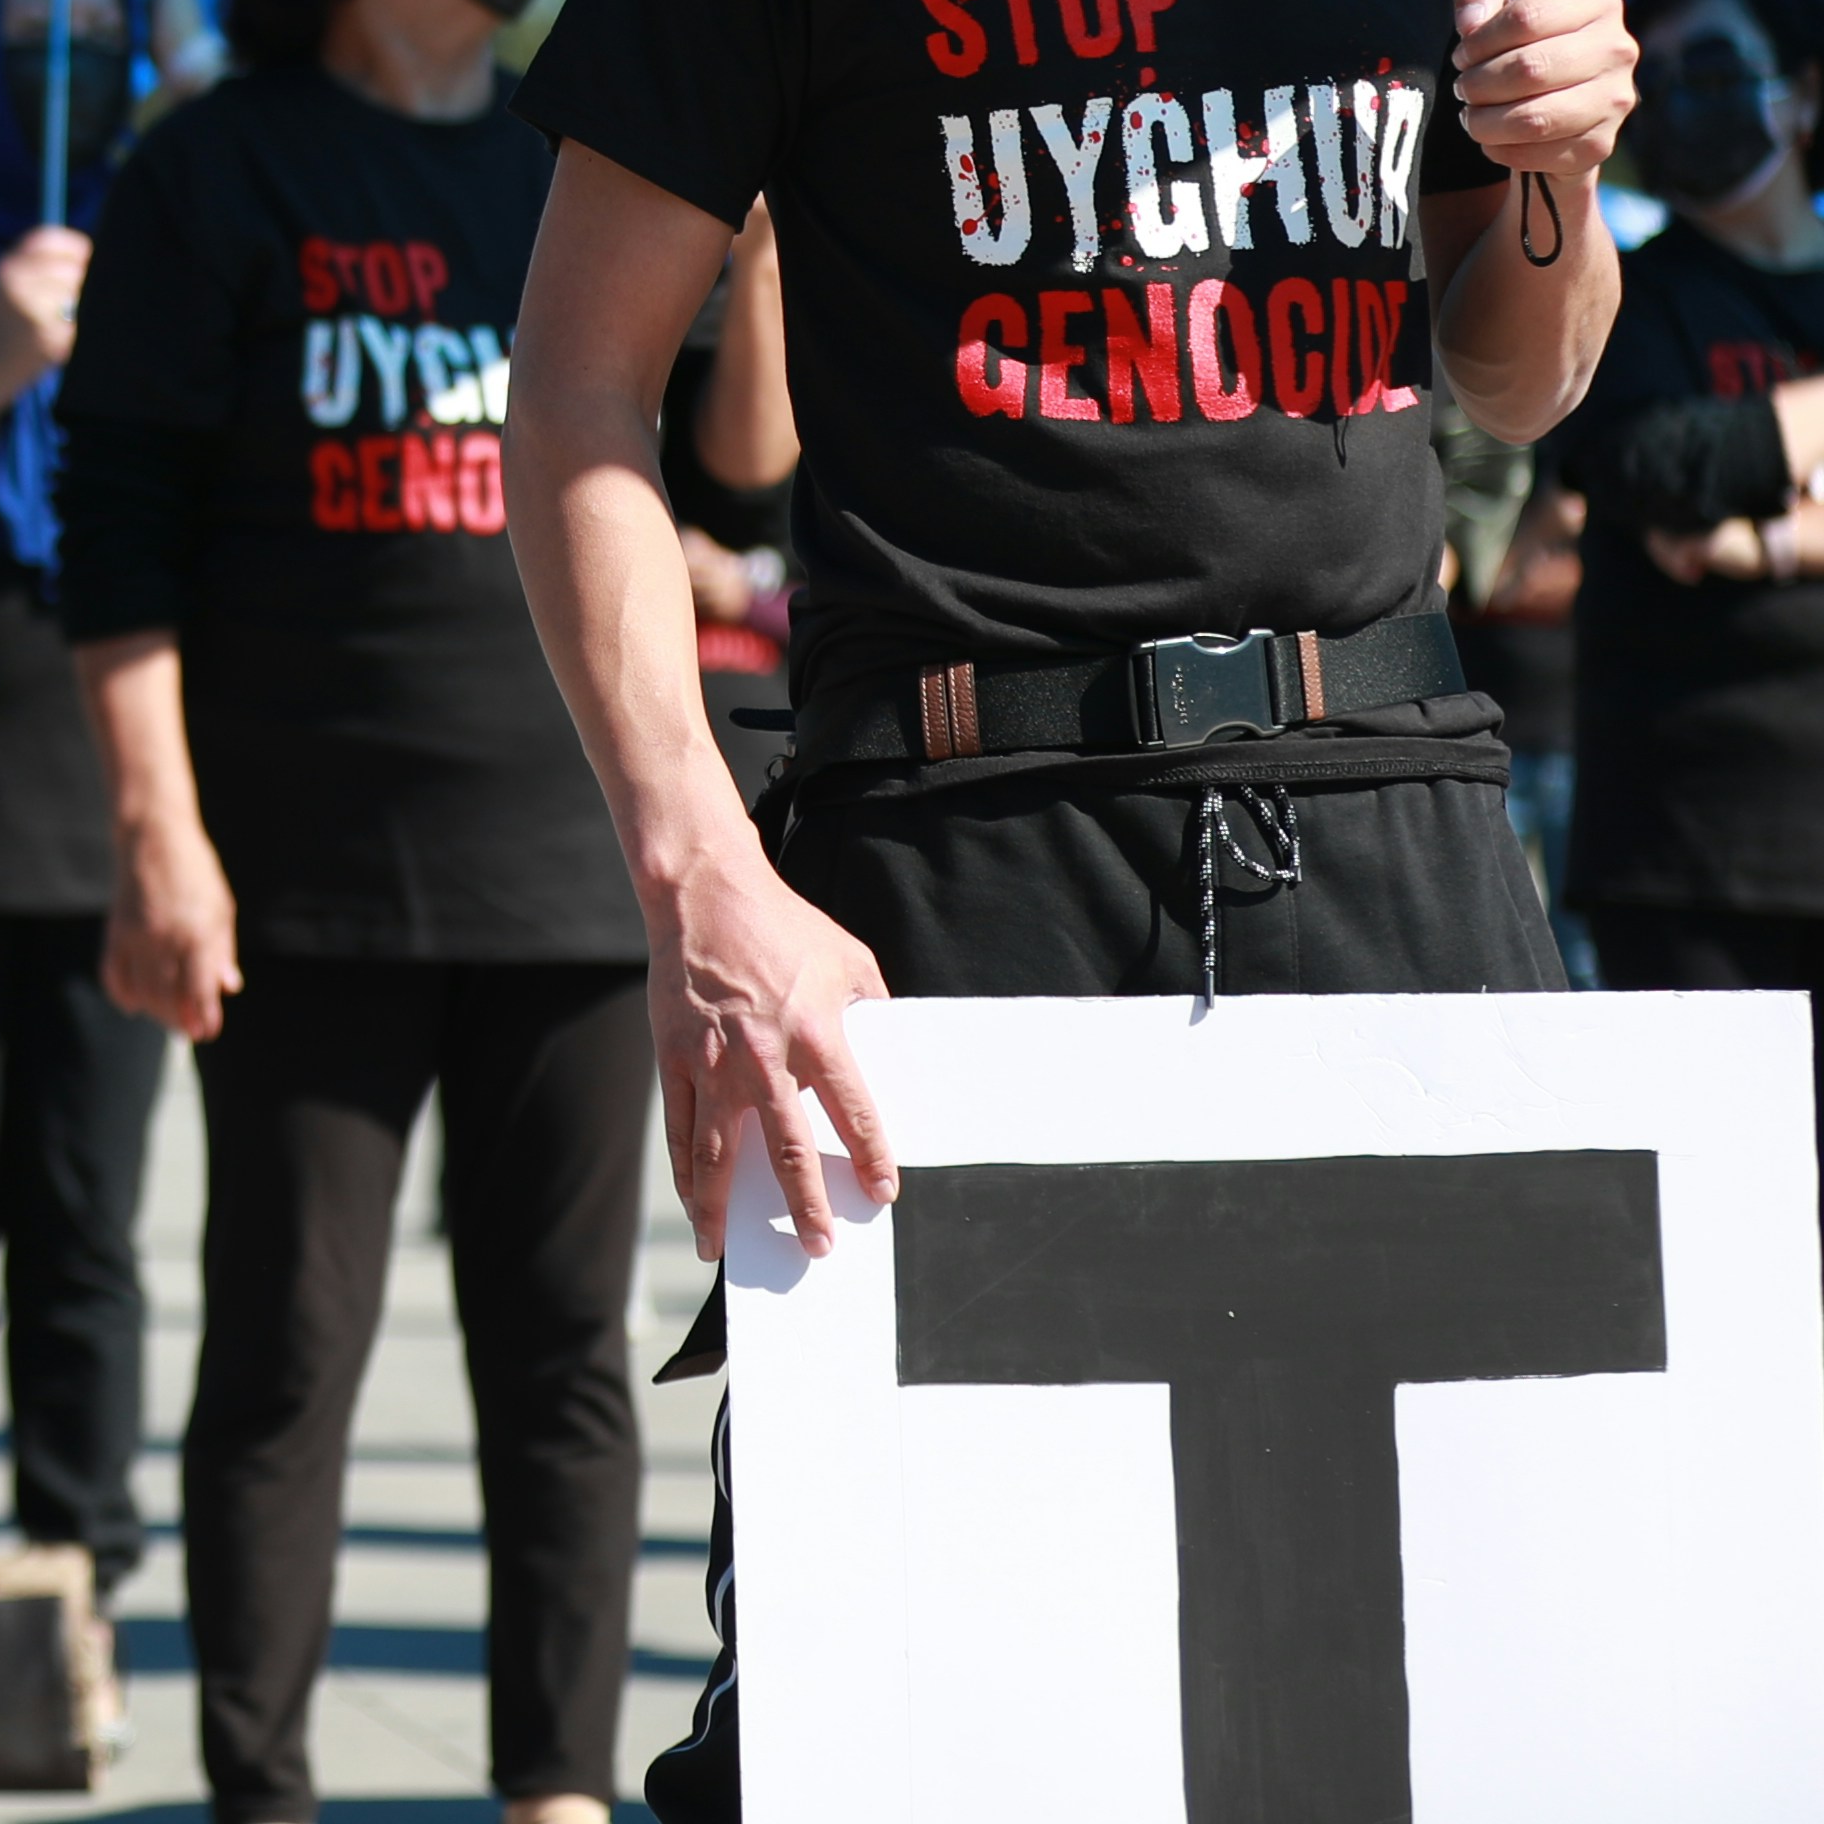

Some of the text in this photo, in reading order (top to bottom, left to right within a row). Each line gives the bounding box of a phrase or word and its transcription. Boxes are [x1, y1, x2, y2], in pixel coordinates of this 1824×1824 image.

[938, 78, 1425, 273] UYGHUR
[299, 234, 449, 319] STOP
[891, 1149, 1668, 1824] T
